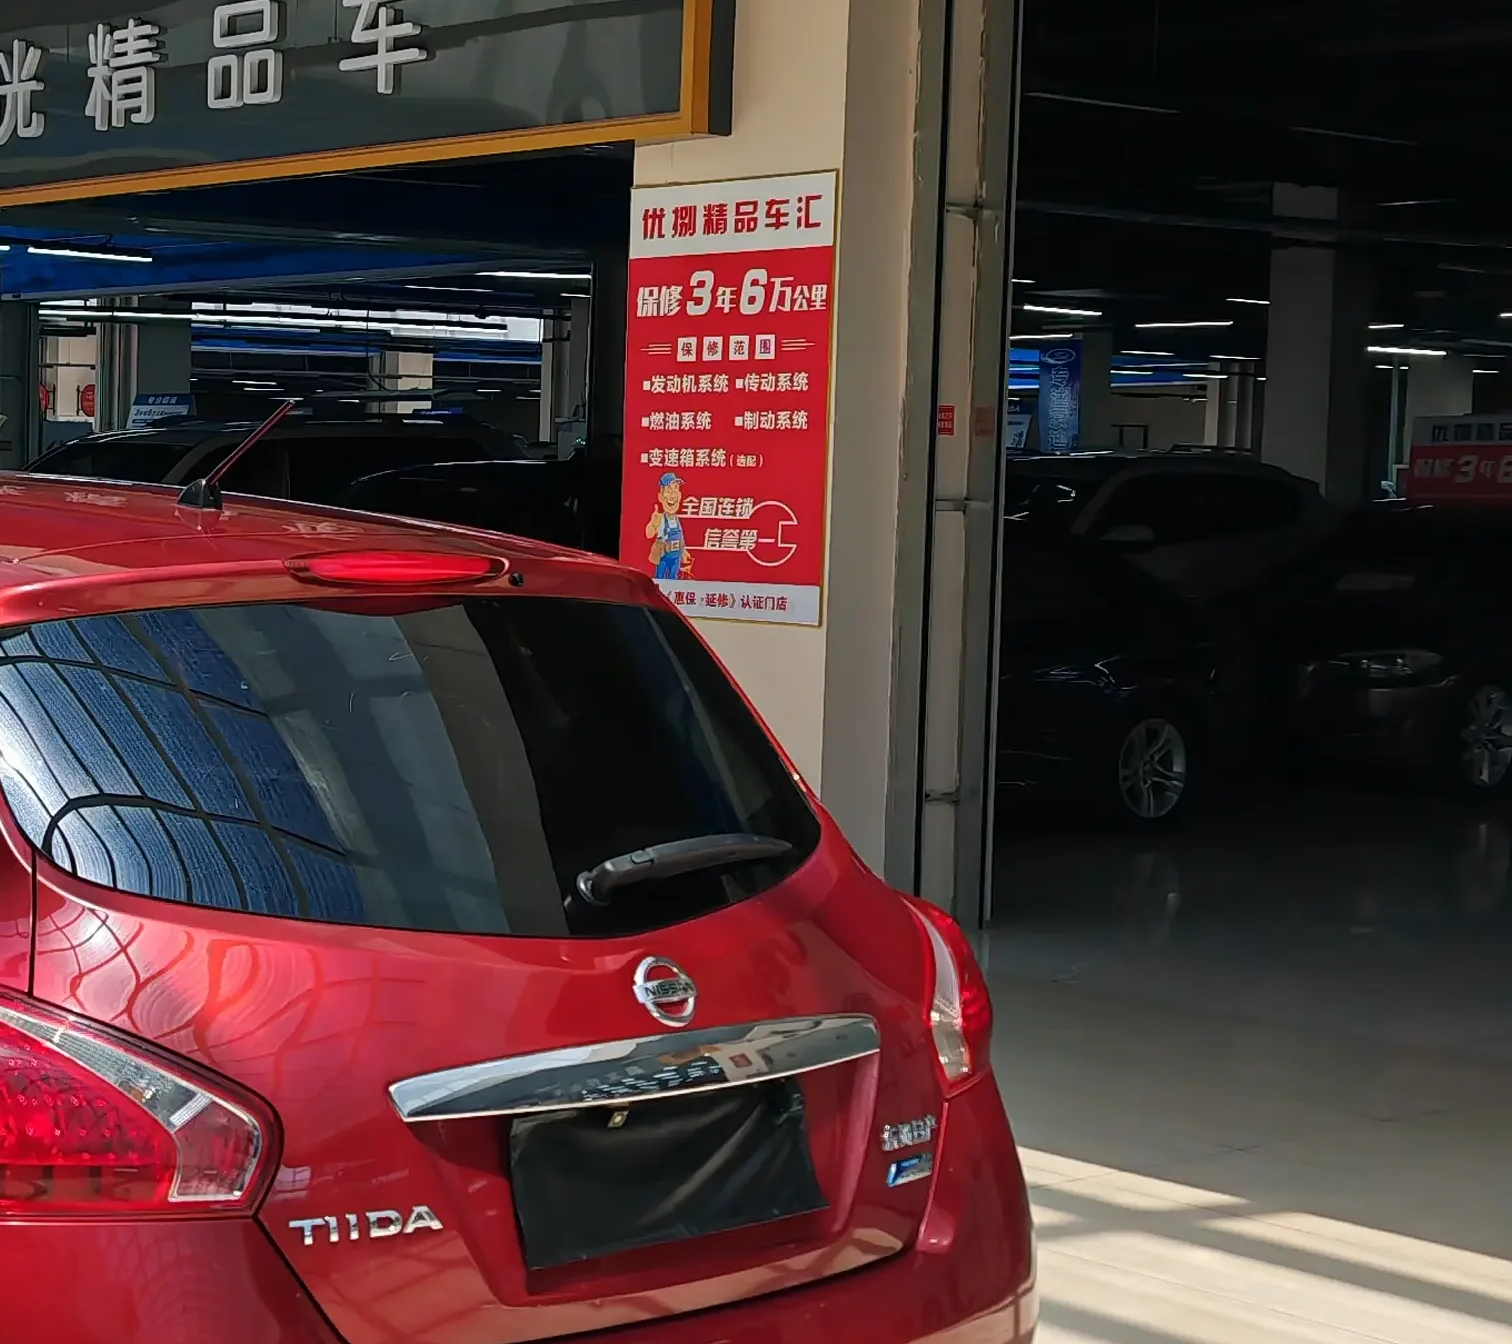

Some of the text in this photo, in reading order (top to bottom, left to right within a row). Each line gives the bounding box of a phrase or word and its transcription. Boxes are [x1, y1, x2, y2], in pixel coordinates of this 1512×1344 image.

[642, 194, 823, 240] 优捌精品车汇
[636, 268, 827, 317] 保修3年6万公里
[650, 371, 809, 394] 发动机系统 传动系统
[649, 409, 808, 431] 燃油系统 制动系统
[682, 497, 754, 517] 全国连锁
[704, 528, 776, 550] 信誉第一
[289, 1205, 444, 1246] TIIDA
